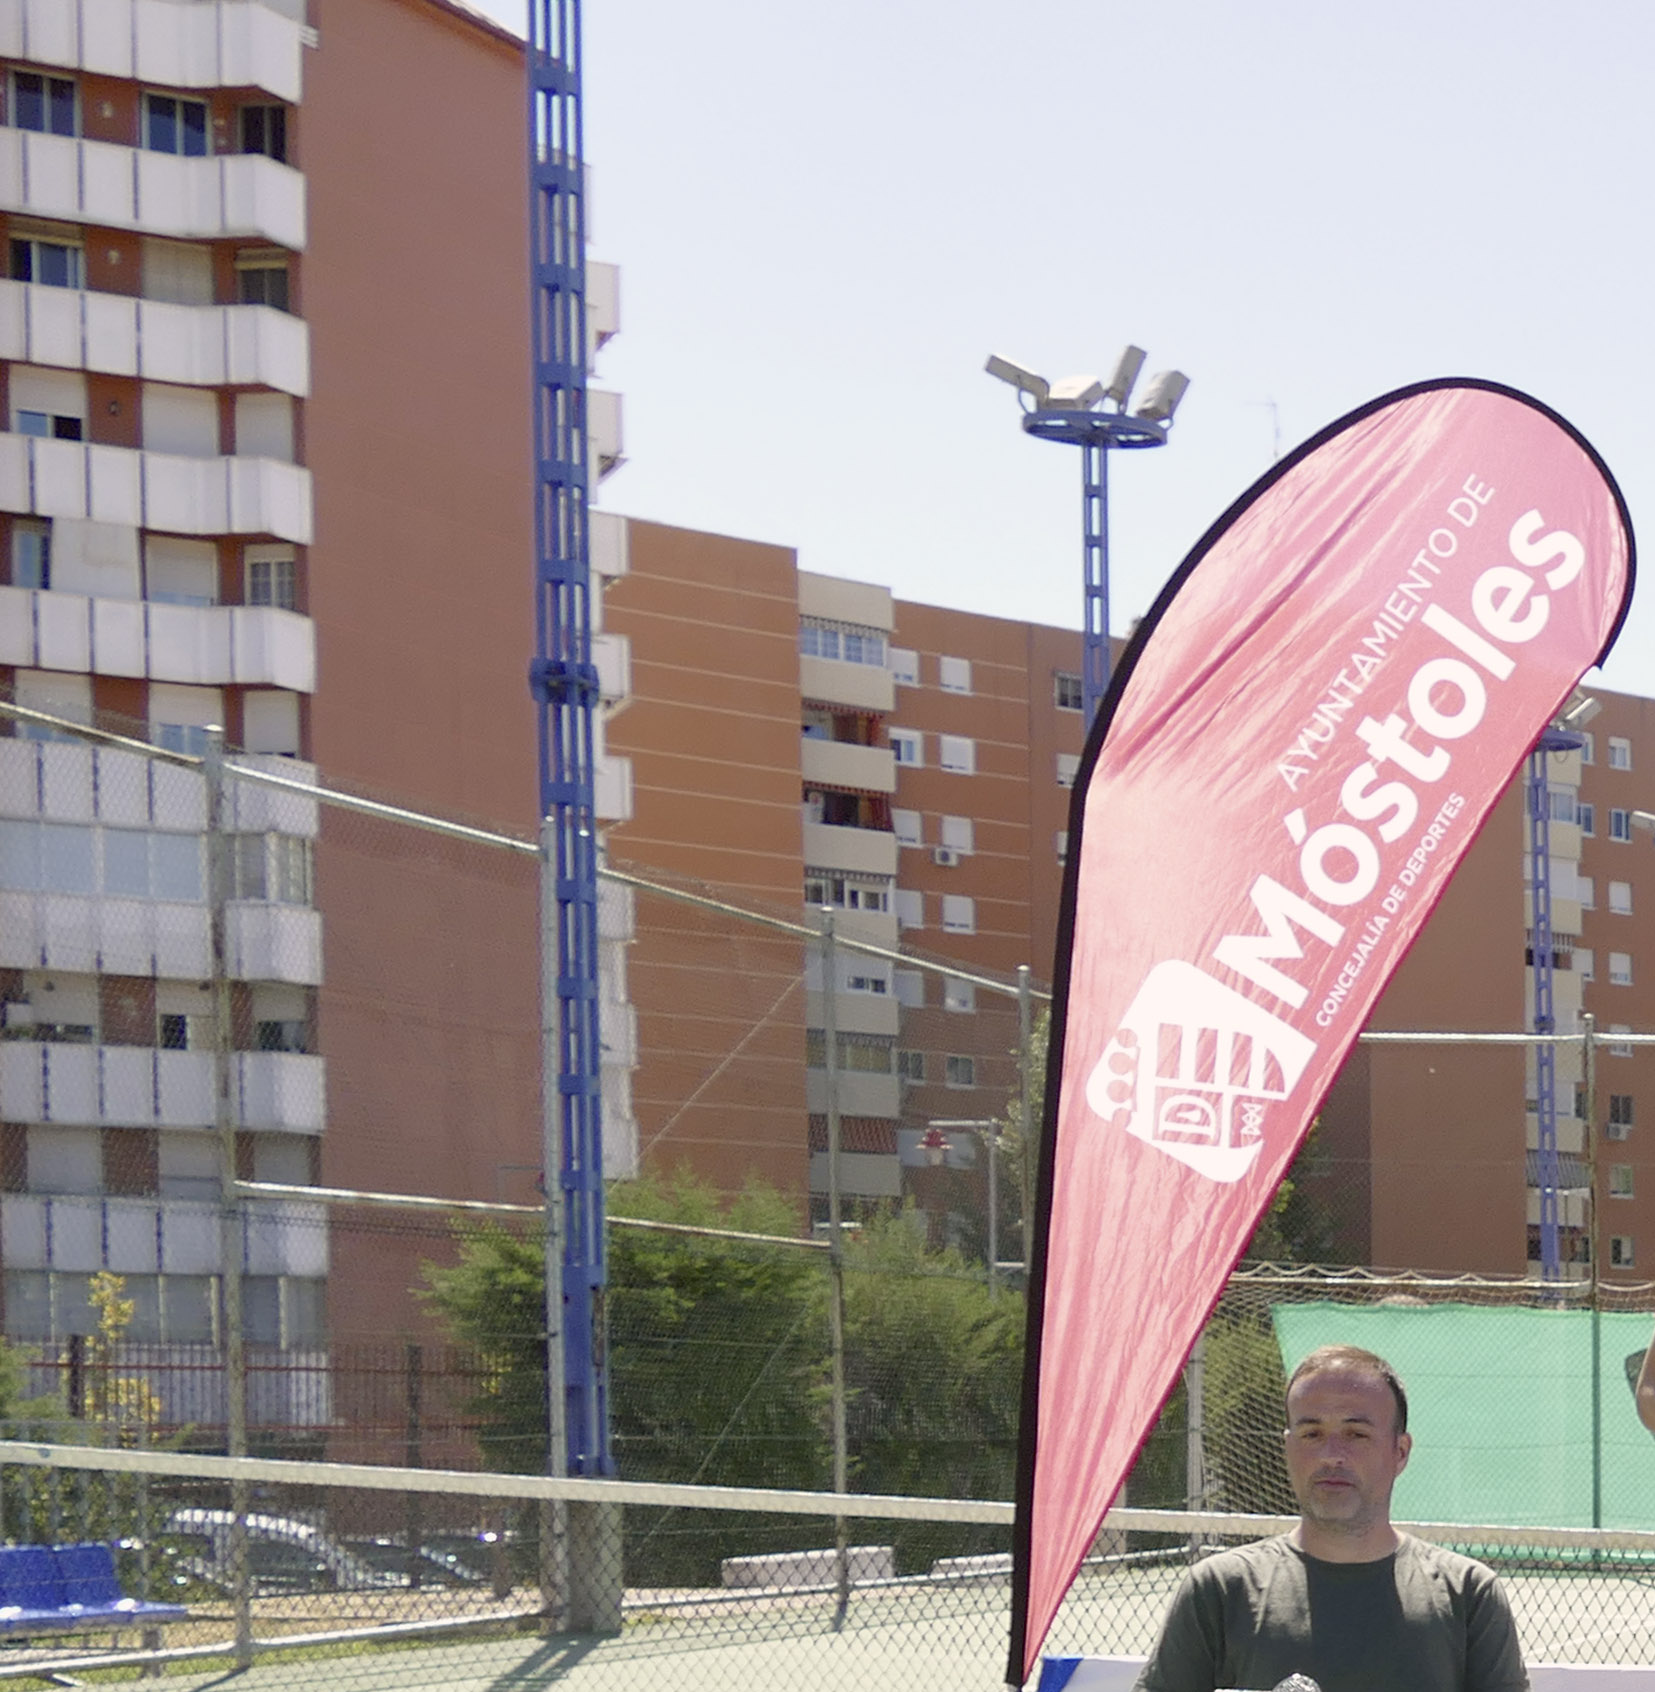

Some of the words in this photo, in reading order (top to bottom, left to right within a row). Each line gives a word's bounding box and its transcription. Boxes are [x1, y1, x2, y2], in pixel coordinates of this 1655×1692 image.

[1212, 507, 1586, 1009] Móstoles
[1276, 527, 1459, 793] AYUNTAMIENTO
[1446, 472, 1496, 528] DE
[1315, 913, 1390, 1027] CONCEJALÍA
[1382, 884, 1407, 914] DE
[1398, 792, 1465, 888] DEPORTES
